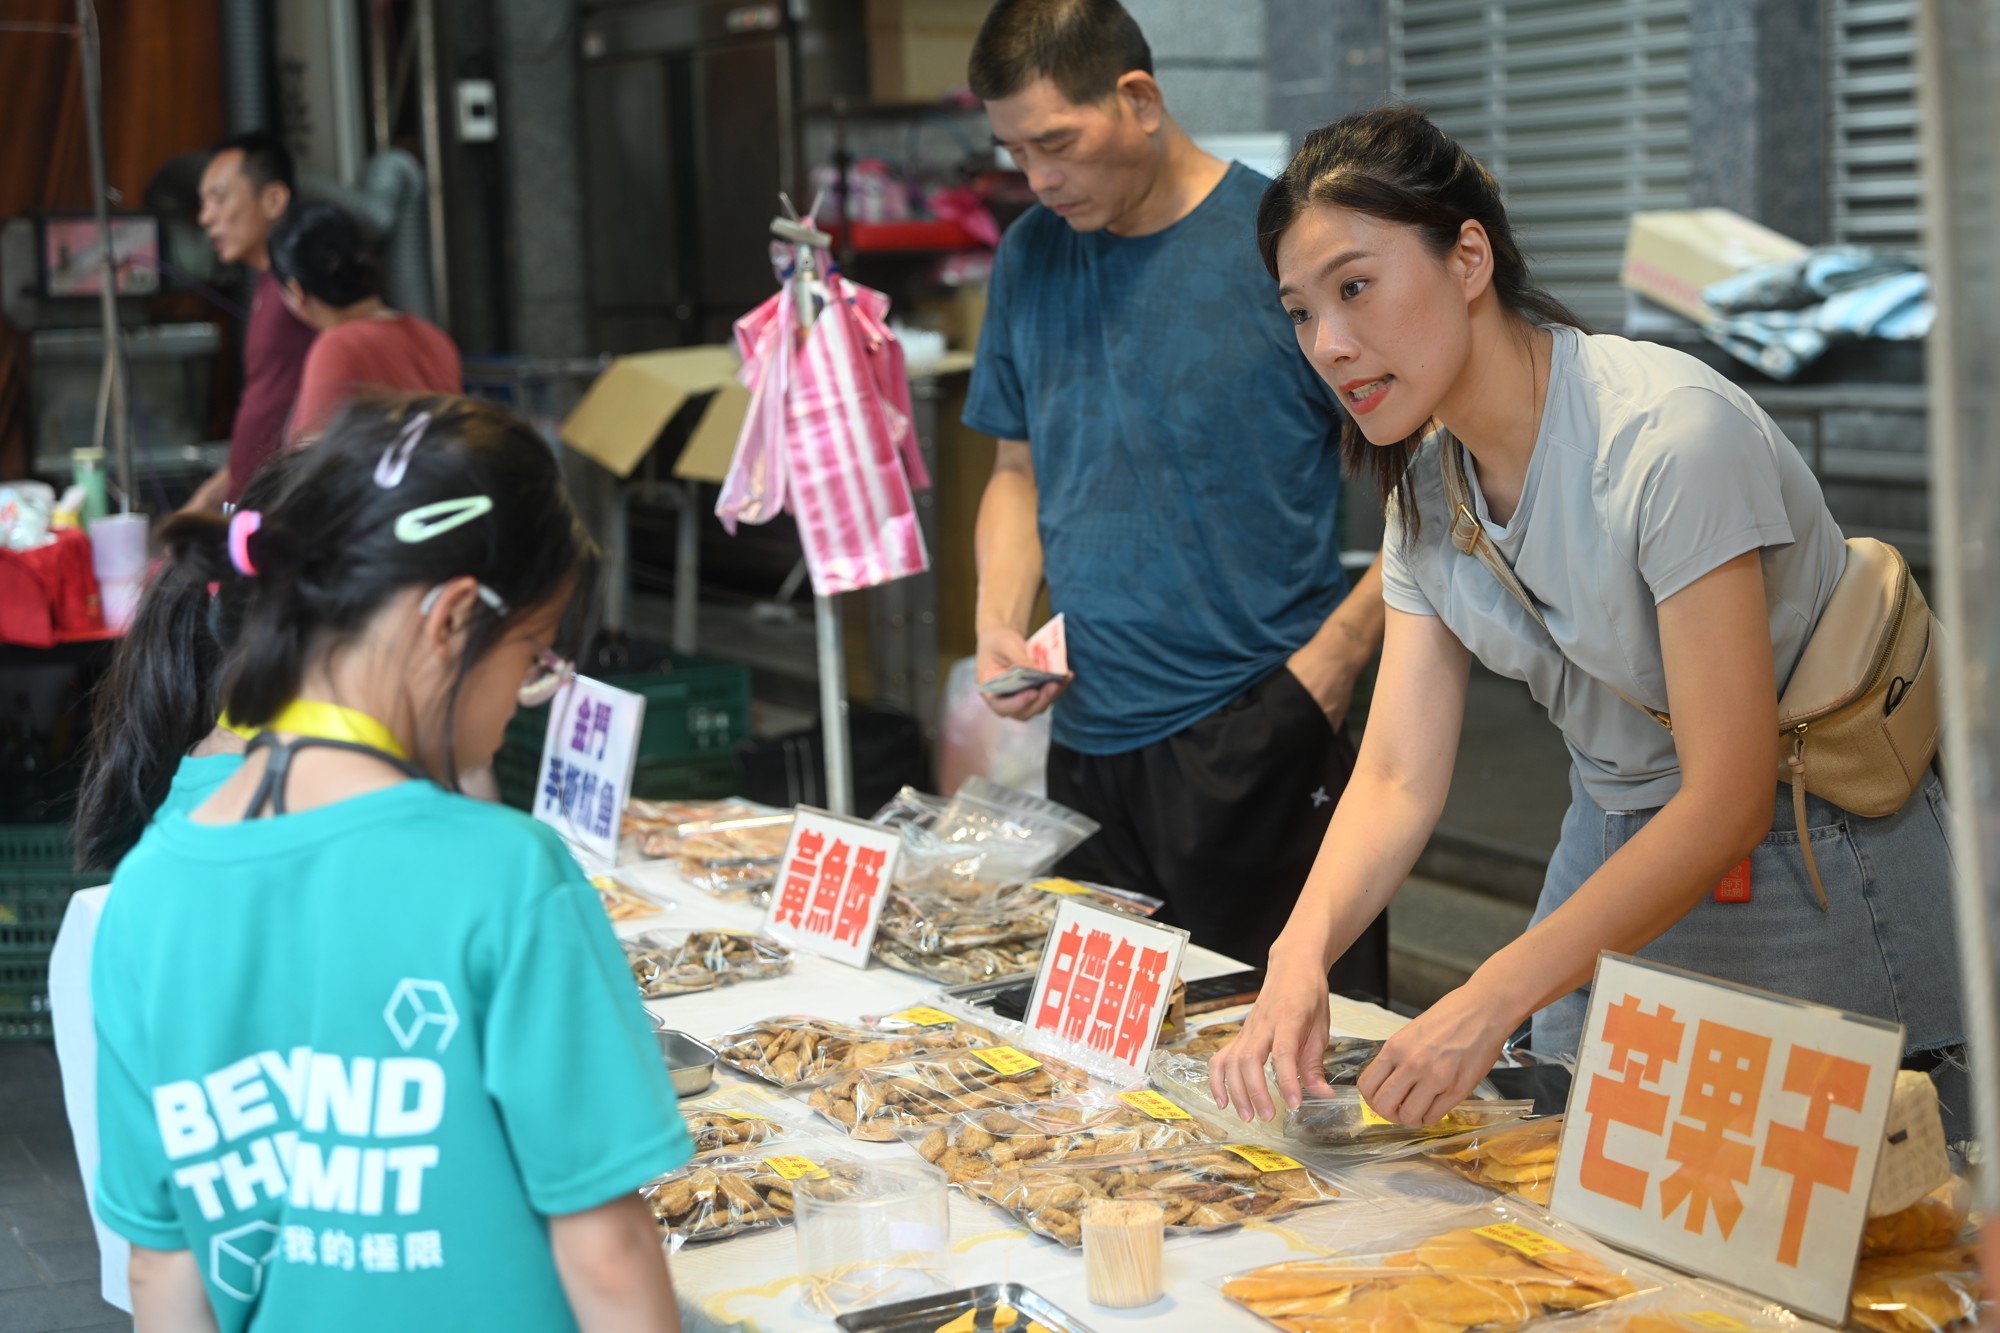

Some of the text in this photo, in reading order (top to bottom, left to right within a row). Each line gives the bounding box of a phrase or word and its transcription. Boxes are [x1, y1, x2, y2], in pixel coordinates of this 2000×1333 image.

[774, 828, 887, 948] 黃魚酥
[1035, 921, 1169, 1067] 白帶魚酥
[152, 1046, 446, 1161] BEYND
[1579, 993, 1871, 1269] 芒果干
[289, 1141, 440, 1217] MIT
[282, 1225, 445, 1273] 我的極限
